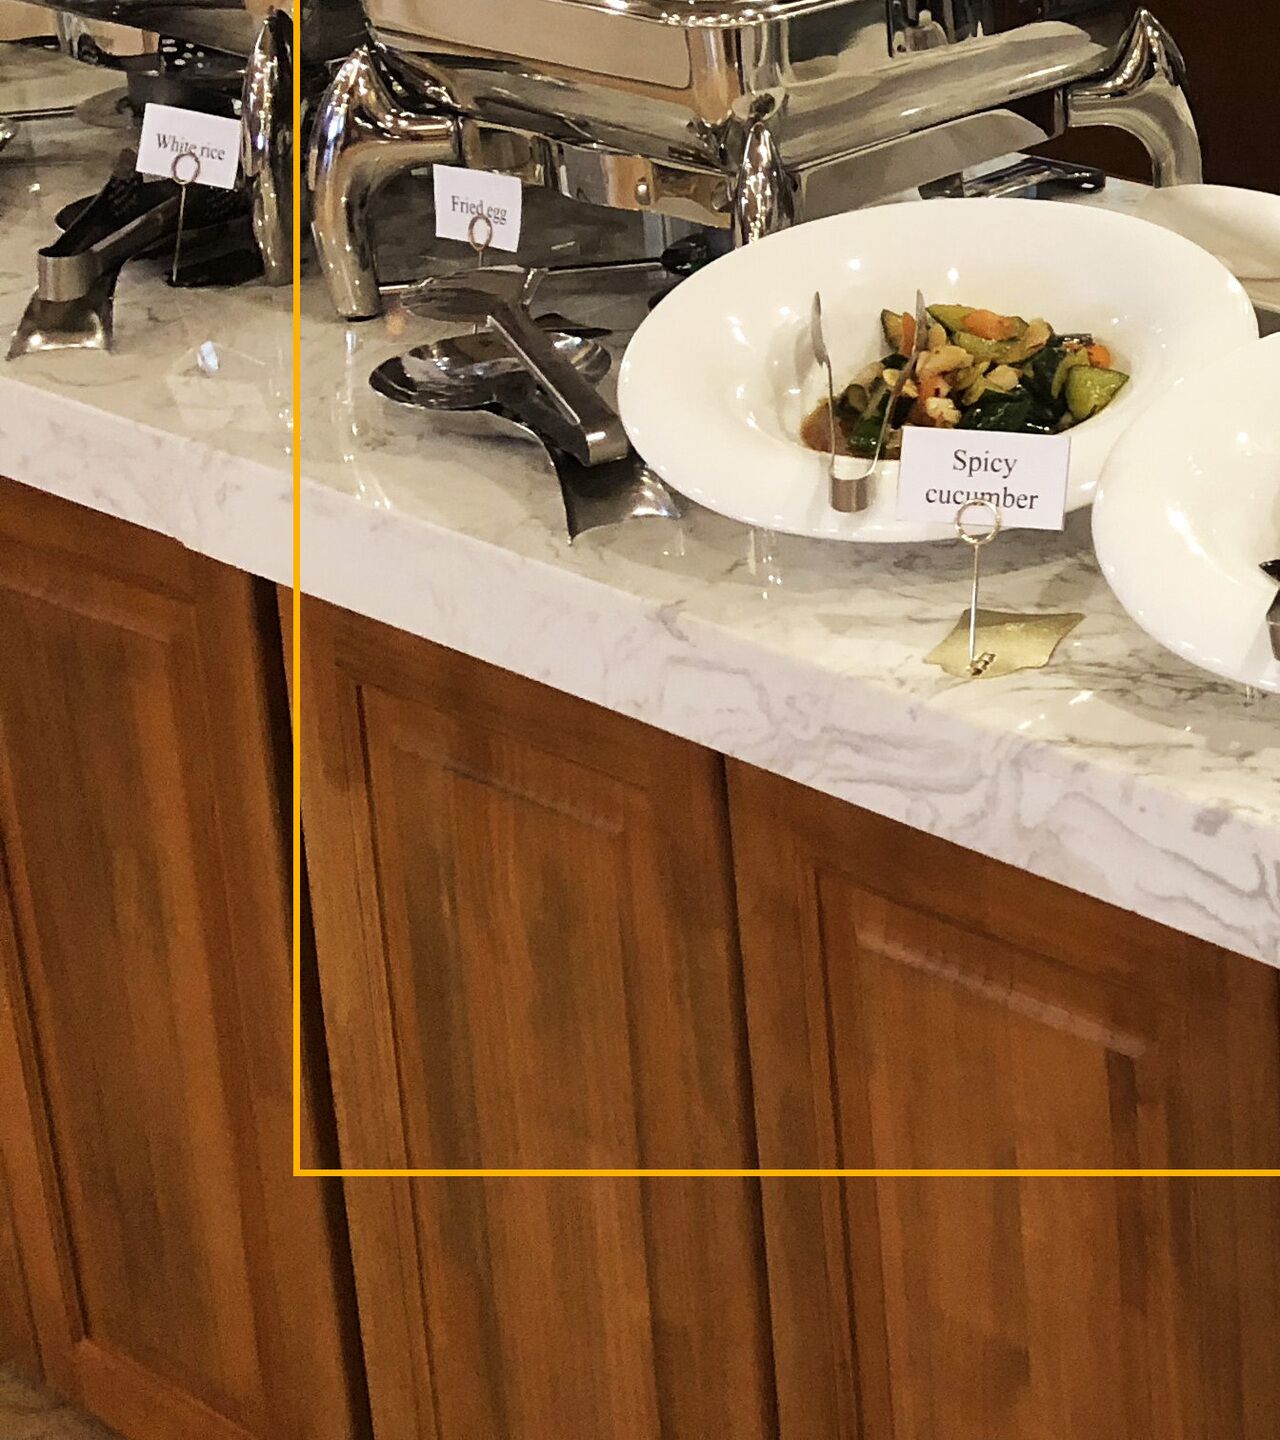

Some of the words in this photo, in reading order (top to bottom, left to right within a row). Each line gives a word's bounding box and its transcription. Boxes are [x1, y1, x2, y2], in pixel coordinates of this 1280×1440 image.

[156, 133, 198, 155] White
[200, 142, 226, 161] rice
[450, 195, 484, 216] Fried
[486, 205, 508, 226] egg
[952, 448, 1018, 479] Spicy
[925, 486, 1039, 510] cucumber
